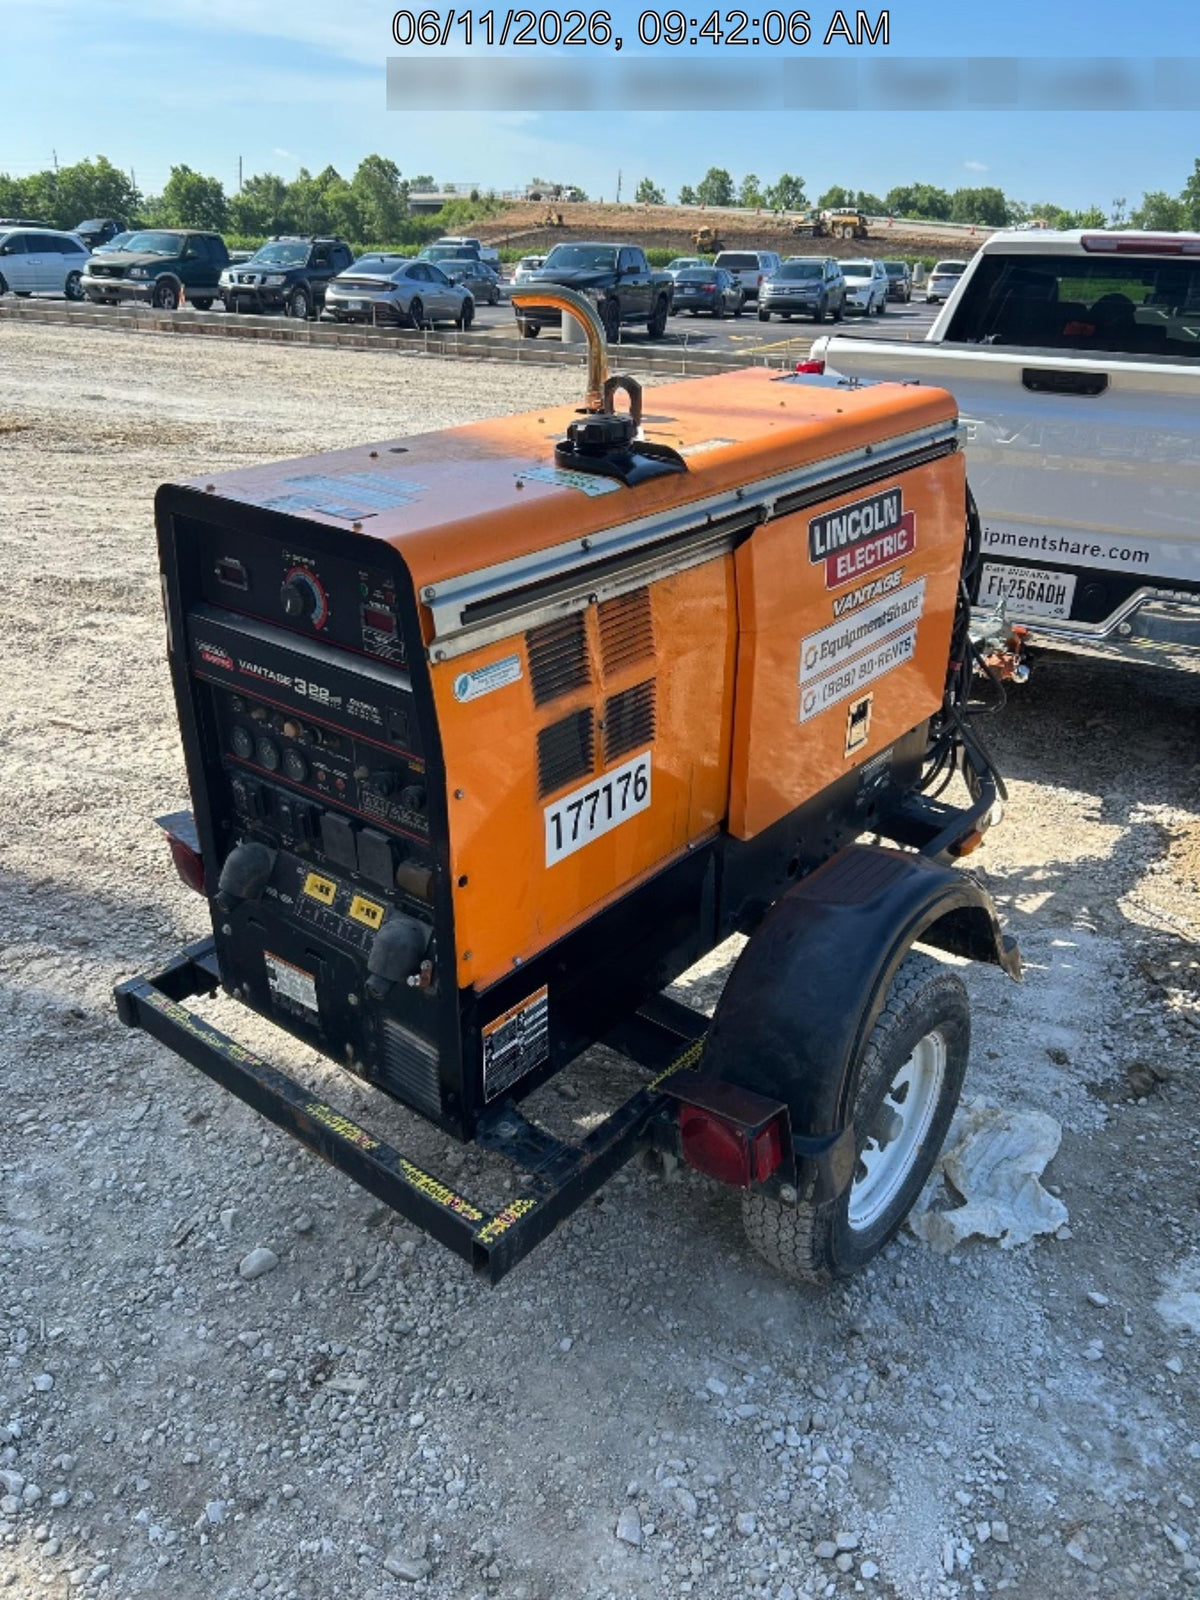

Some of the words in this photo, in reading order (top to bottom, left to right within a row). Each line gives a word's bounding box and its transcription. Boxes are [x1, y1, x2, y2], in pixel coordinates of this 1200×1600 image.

[813, 495, 898, 556] LINCOLN
[836, 528, 909, 580] ELECTRIC
[832, 567, 904, 617] VANTAGE
[819, 593, 921, 661] EquipmentShare
[550, 763, 649, 851] 177176
